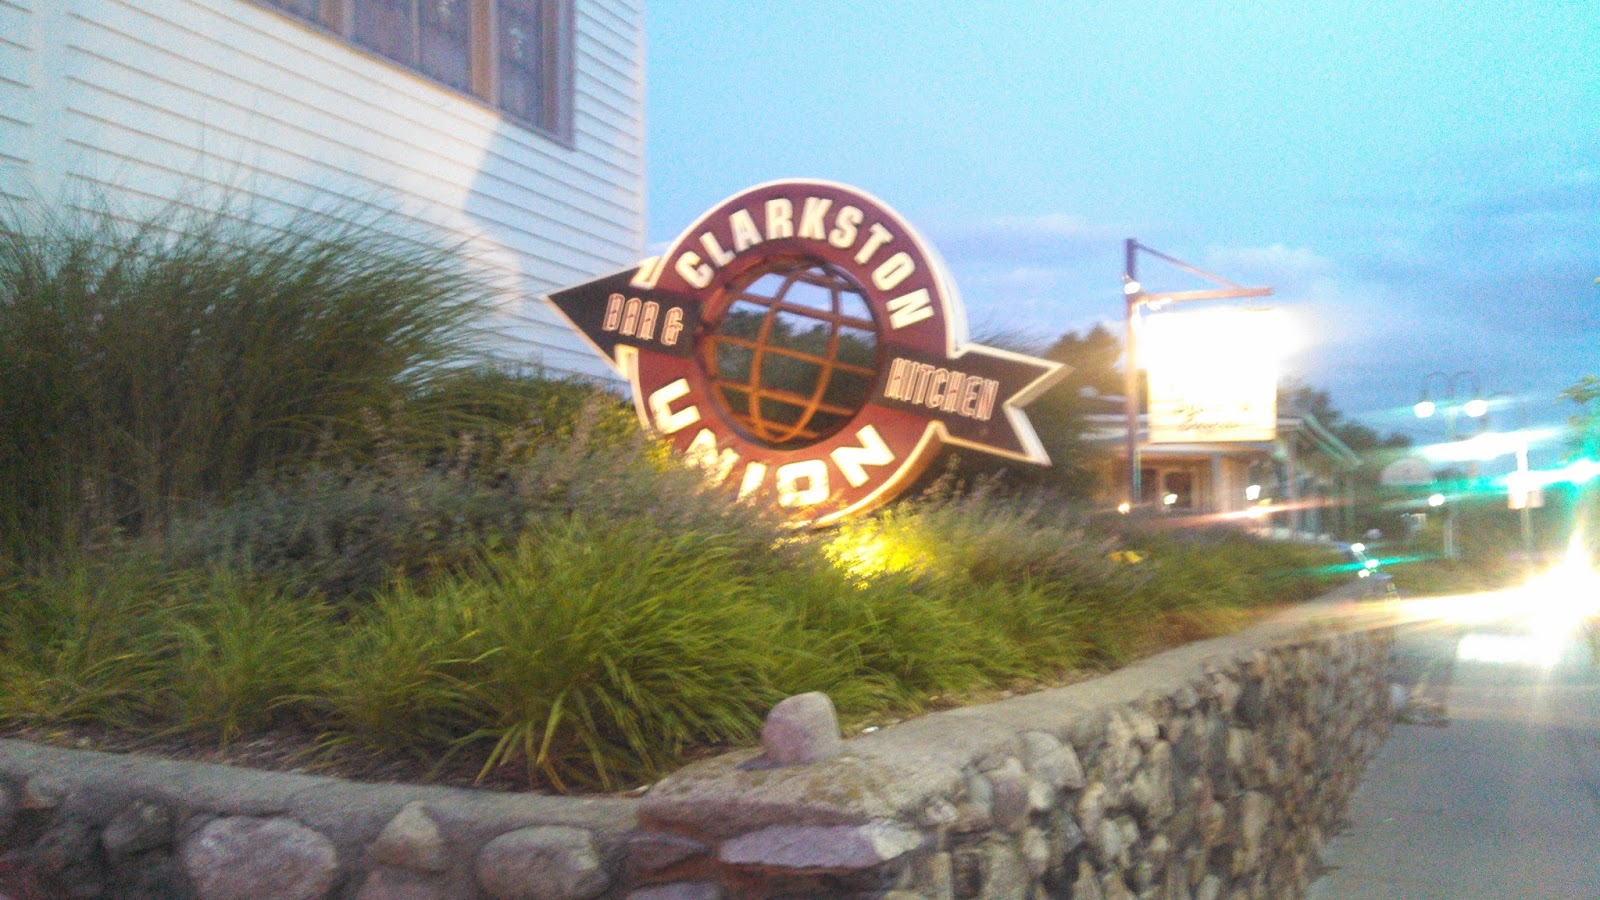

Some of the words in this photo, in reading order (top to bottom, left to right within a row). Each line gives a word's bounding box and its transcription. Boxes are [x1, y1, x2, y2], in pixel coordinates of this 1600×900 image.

[675, 197, 935, 330] CLARKSTON
[602, 293, 660, 341] BAR
[884, 357, 999, 421] KITCHEN
[648, 378, 896, 508] UNION
